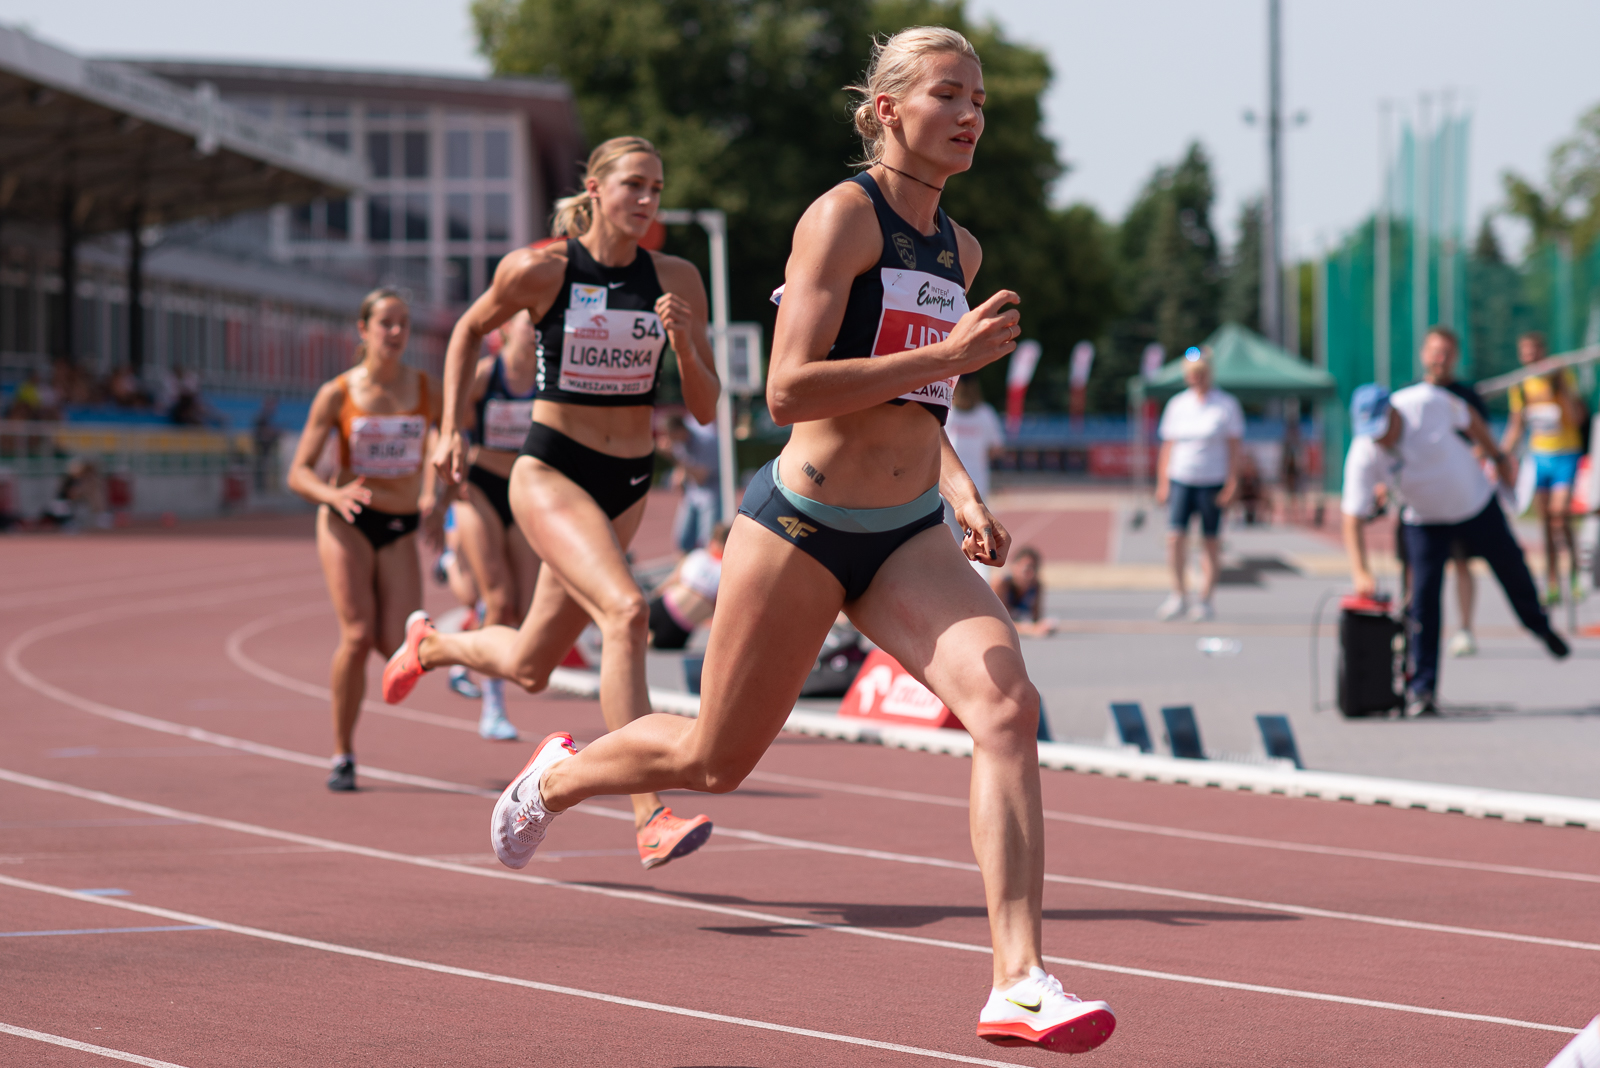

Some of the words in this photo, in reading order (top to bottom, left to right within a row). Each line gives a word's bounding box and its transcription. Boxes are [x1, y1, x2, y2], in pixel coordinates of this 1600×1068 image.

[937, 249, 955, 269] 4F
[916, 281, 955, 314] Europol
[631, 317, 661, 340] 54
[904, 323, 951, 349] LID
[569, 345, 653, 369] LIGARSKA
[776, 516, 818, 539] 4F
